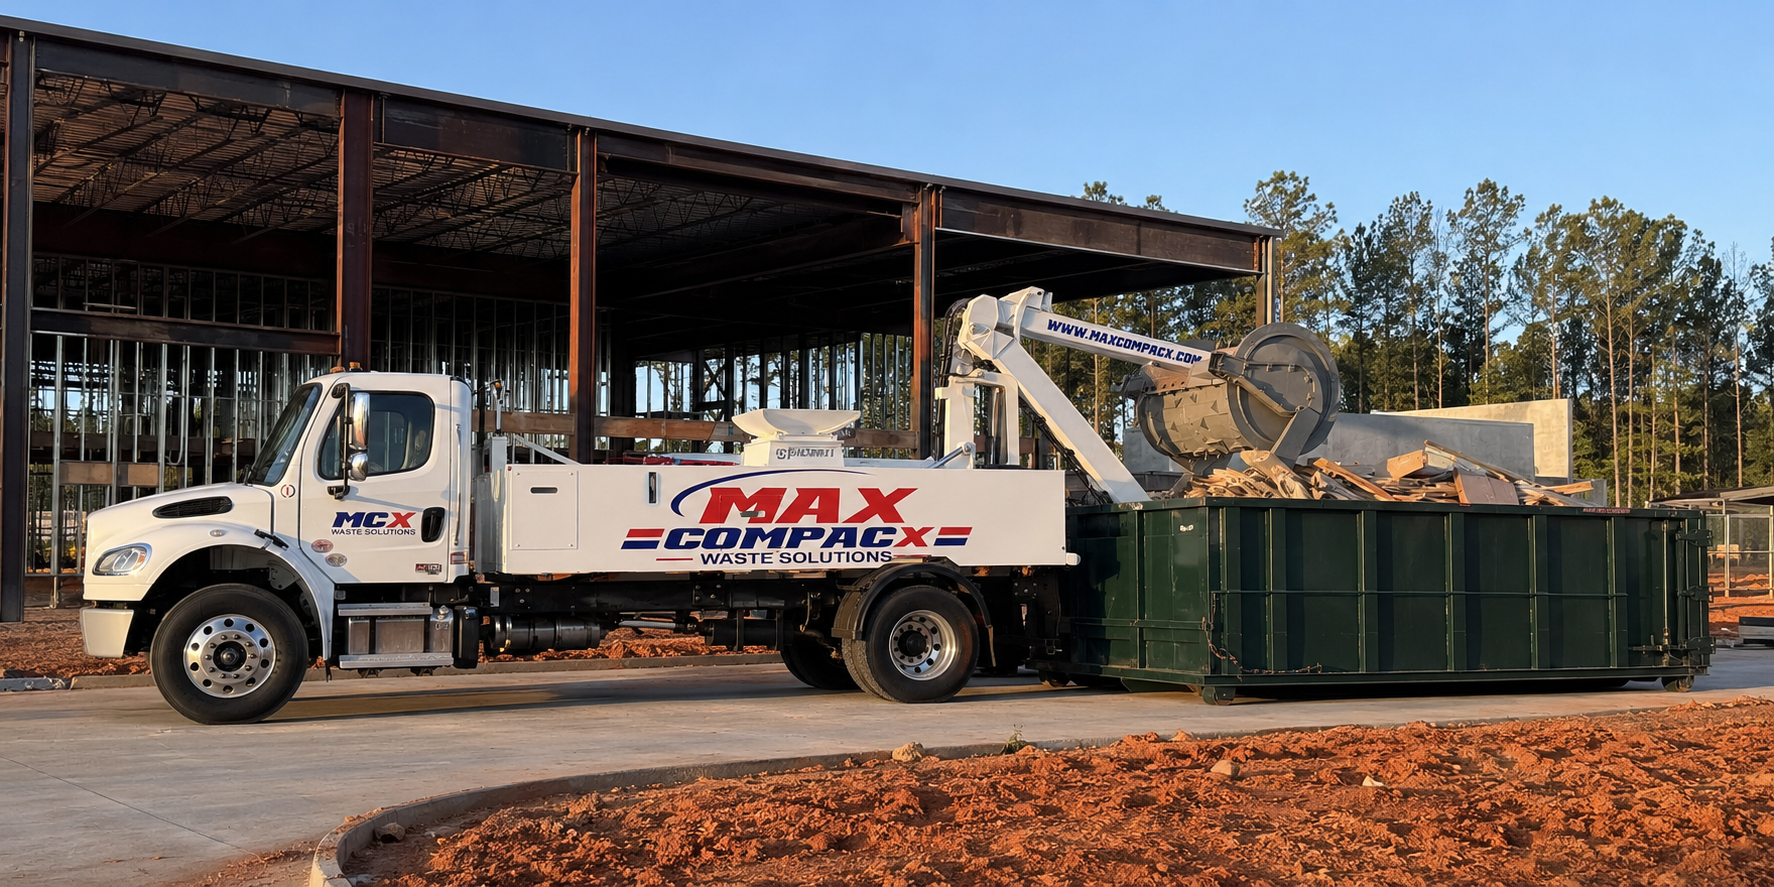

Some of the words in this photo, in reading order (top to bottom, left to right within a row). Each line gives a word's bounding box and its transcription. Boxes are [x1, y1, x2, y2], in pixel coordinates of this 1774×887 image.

[1047, 319, 1203, 364] WWW.MAXCOMPACX.COM
[700, 487, 917, 524] MAX
[331, 511, 416, 528] MCX
[331, 528, 363, 536] WASTE
[364, 528, 417, 536] SOLUTIONS
[664, 526, 934, 550] COMPACX
[700, 552, 774, 565] WASTE
[778, 551, 893, 564] SOLUTIONS
